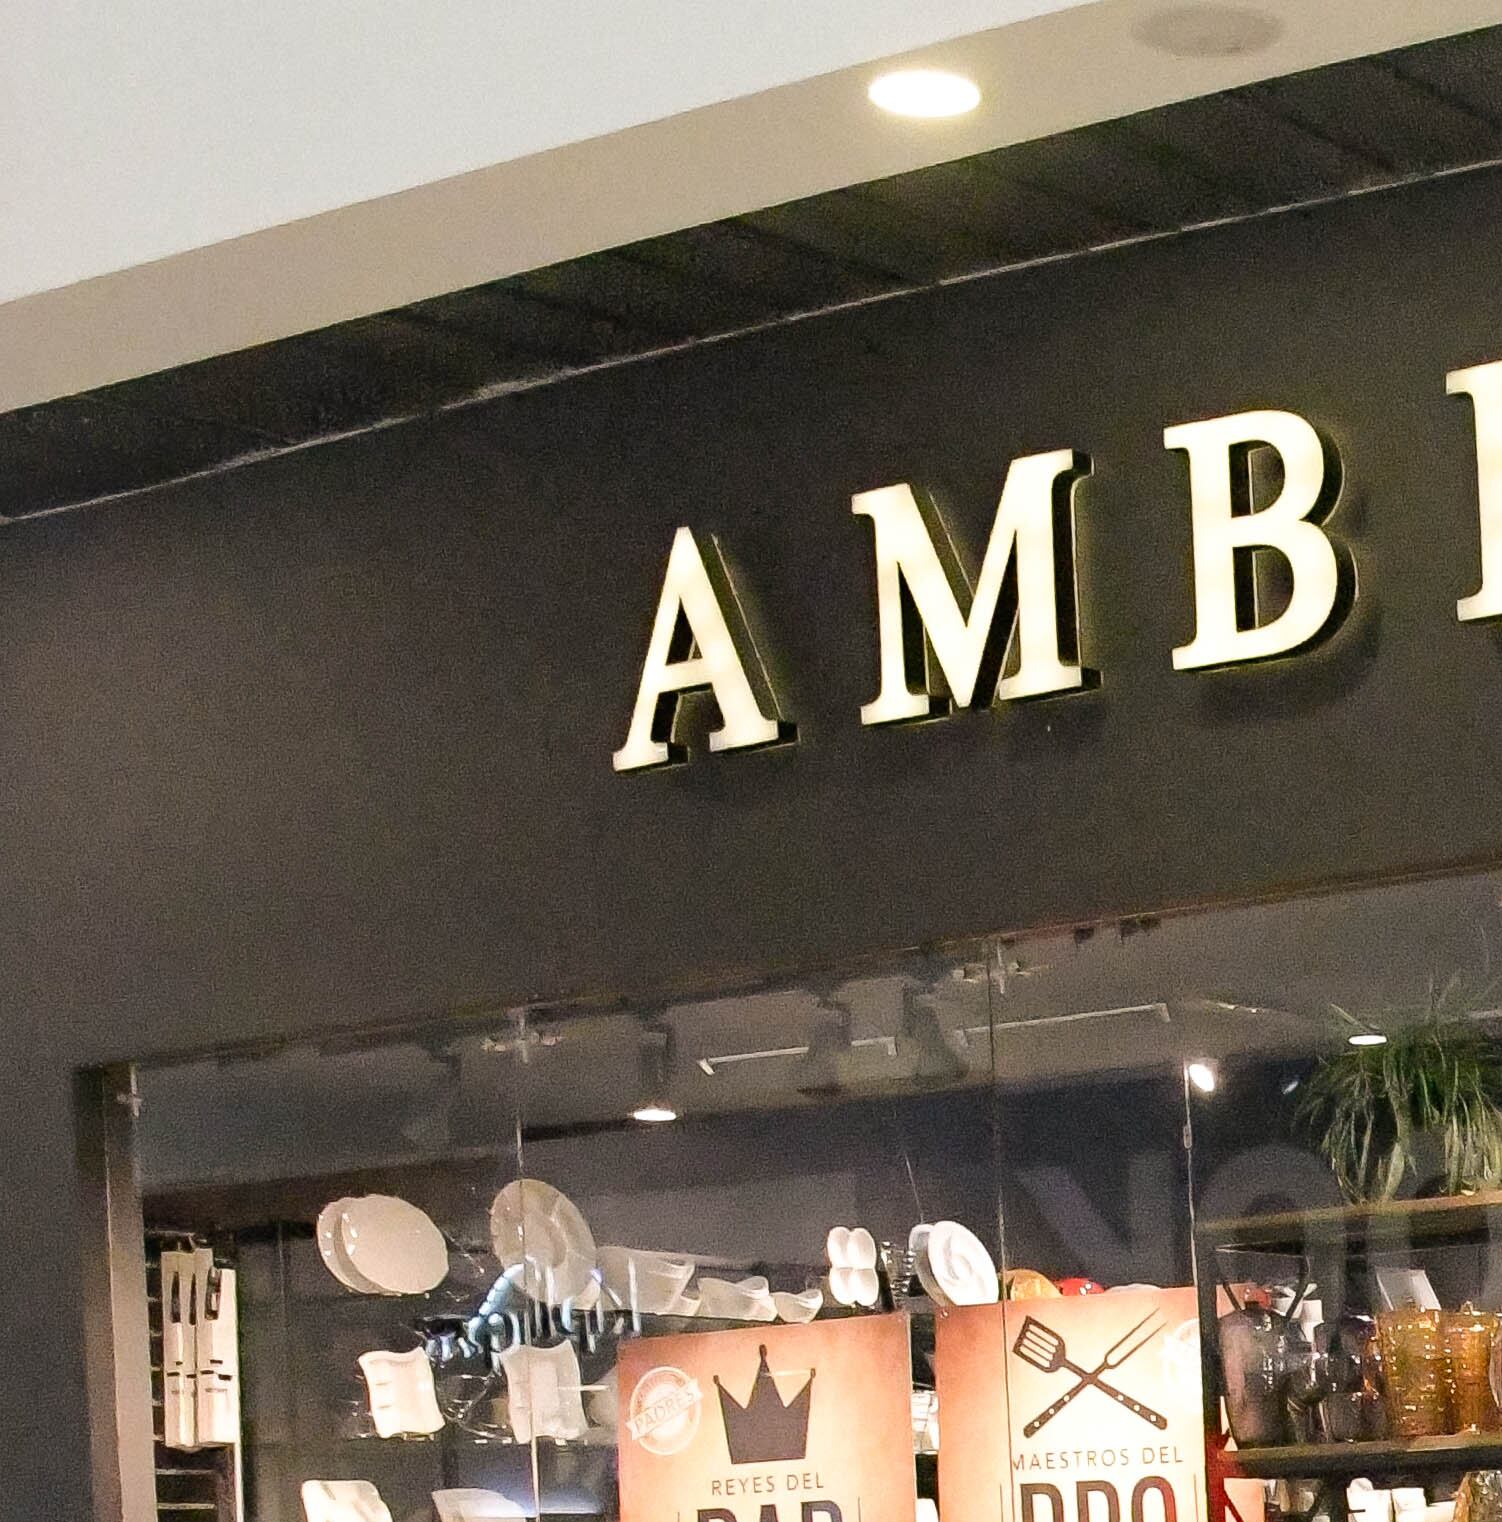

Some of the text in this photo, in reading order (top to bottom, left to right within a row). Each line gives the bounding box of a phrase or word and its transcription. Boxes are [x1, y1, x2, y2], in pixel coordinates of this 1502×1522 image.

[1012, 1446, 1183, 1471] MAESTROS DEL
[711, 1472, 825, 1496] REYES DEL
